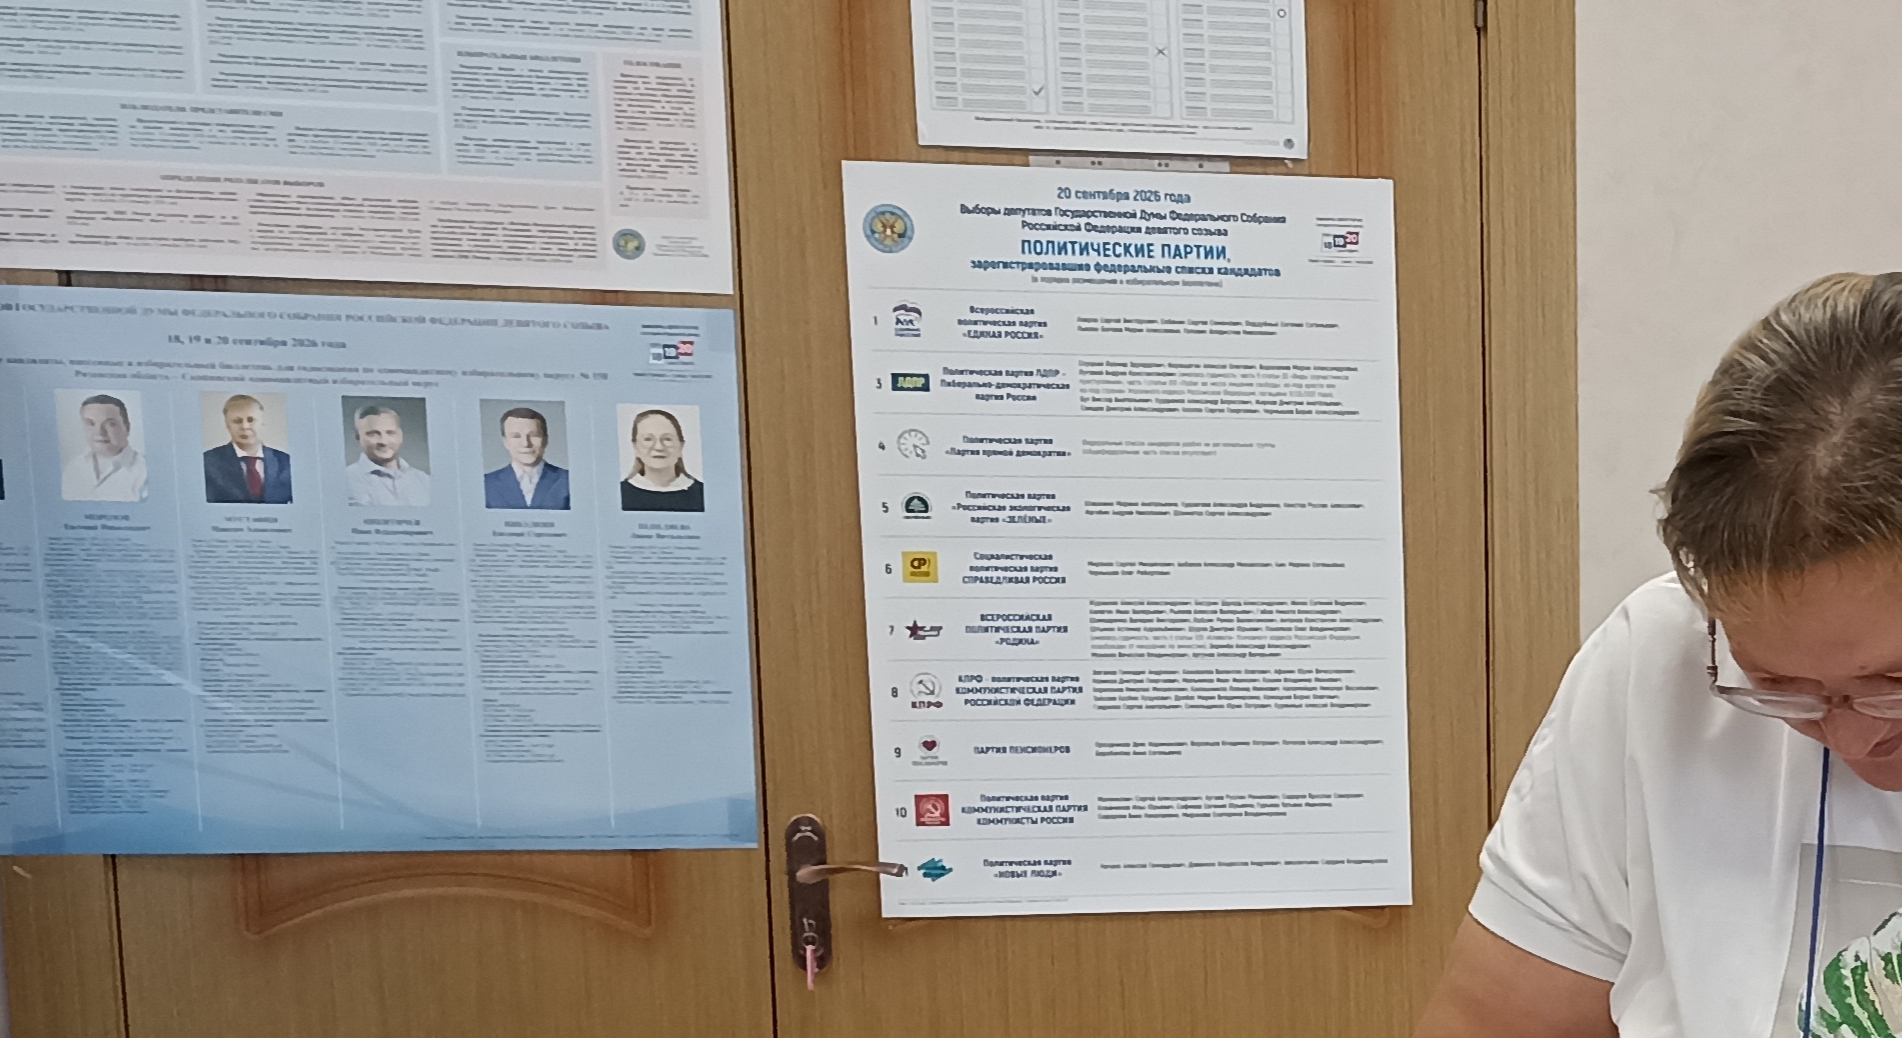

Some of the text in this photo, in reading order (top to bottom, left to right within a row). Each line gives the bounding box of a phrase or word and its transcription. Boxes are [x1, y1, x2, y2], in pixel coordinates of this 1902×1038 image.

[1057, 187, 1191, 204] 20 сентября 2026 года
[960, 203, 1286, 224] Выборы депутатов Государственной Думы Федерального Собрания
[1021, 220, 1228, 237] Российской Федерации девятого созыва
[1021, 239, 1231, 263] ПОЛИТИЧЕСКИЕ ПАРТИИ,
[970, 258, 1281, 278] зарегистрировавшие федеральные списки кандидатов
[969, 305, 1034, 315] Всероссийская
[873, 315, 878, 326] 1
[957, 318, 1047, 328] политическая партия
[942, 366, 1003, 376] Политическая
[1005, 370, 1033, 378] партия
[875, 378, 882, 389] 3
[975, 393, 1037, 401] партия России
[878, 440, 886, 451] 4
[962, 435, 1053, 446] Политическая партия
[965, 491, 1056, 501] Политическая партия
[882, 502, 889, 513] 5
[1008, 504, 1071, 513] экологическая
[970, 516, 999, 524] партия
[973, 552, 1053, 562] Социалистическая
[885, 563, 892, 574] 6
[969, 565, 1058, 574] политическая партия
[962, 576, 1066, 585] СПРАВЕДЛИВАЯ РОССИЯ
[980, 612, 1053, 622] ВСЕРОССИЙСКАЯ
[889, 625, 894, 635] 7
[965, 626, 1068, 634] ПОЛИТИЧЕСКАЯ ПАРТИЯ
[958, 675, 983, 683] КПРФ
[1051, 675, 1080, 684] партия
[891, 687, 898, 698] 8
[956, 686, 1083, 695] КОММУНИСТИЧЕСКАЯ ПАРТИЯ
[911, 701, 943, 709] КПРФ
[964, 697, 1076, 707] РОССИЙСКОЙ ФЕДЕРАЦИИ
[894, 747, 901, 758] 9
[974, 746, 1007, 754] ПАРТИЯ
[980, 794, 1039, 802] Политическая
[895, 807, 907, 818] 10
[961, 805, 1088, 814] КОММУНИСТИЧЕСКАЯ ПАРТИЯ
[983, 859, 1042, 867] Политическая
